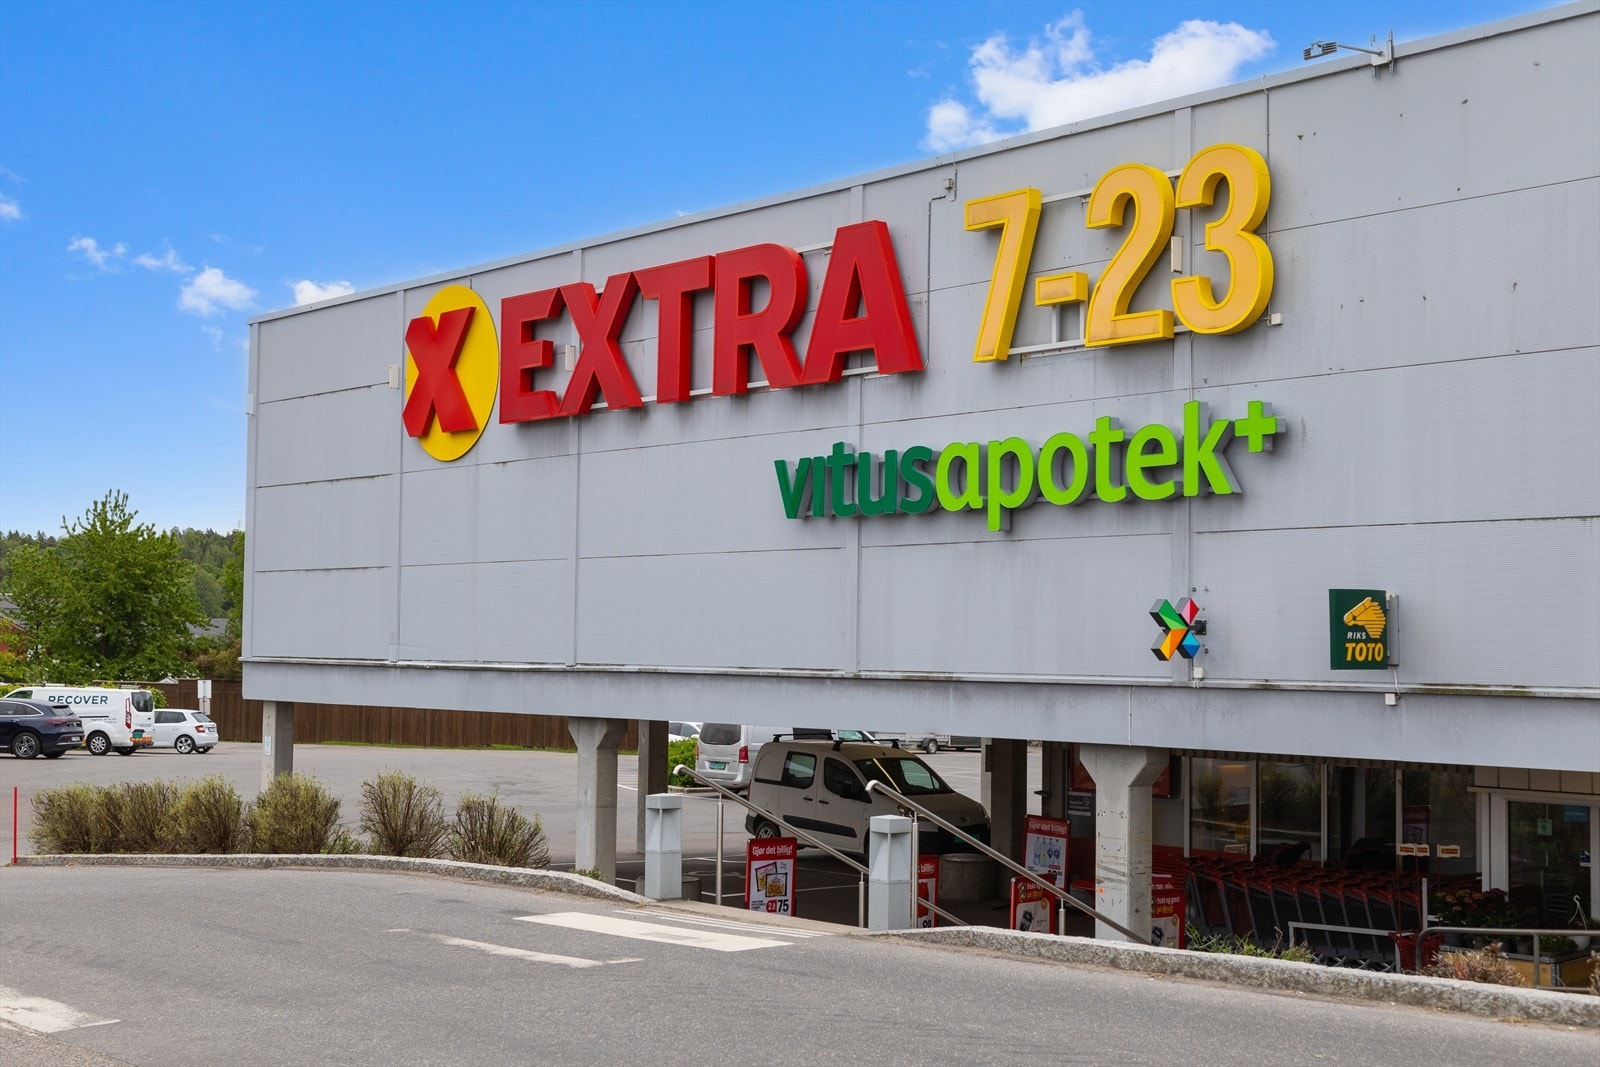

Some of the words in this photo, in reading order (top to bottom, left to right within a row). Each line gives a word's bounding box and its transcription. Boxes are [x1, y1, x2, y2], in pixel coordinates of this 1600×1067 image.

[964, 143, 1274, 364] 7-23
[499, 220, 924, 425] EXTRA
[1347, 631, 1366, 640] RIKS
[1345, 642, 1384, 662] TOTO
[48, 695, 109, 705] RECOVER
[1029, 820, 1041, 830] Gjør
[1041, 822, 1051, 831] det
[1051, 823, 1067, 834] billig!
[753, 846, 765, 857] Gjør
[766, 845, 776, 855] det
[776, 844, 793, 856] billig!
[778, 899, 789, 912] 75
